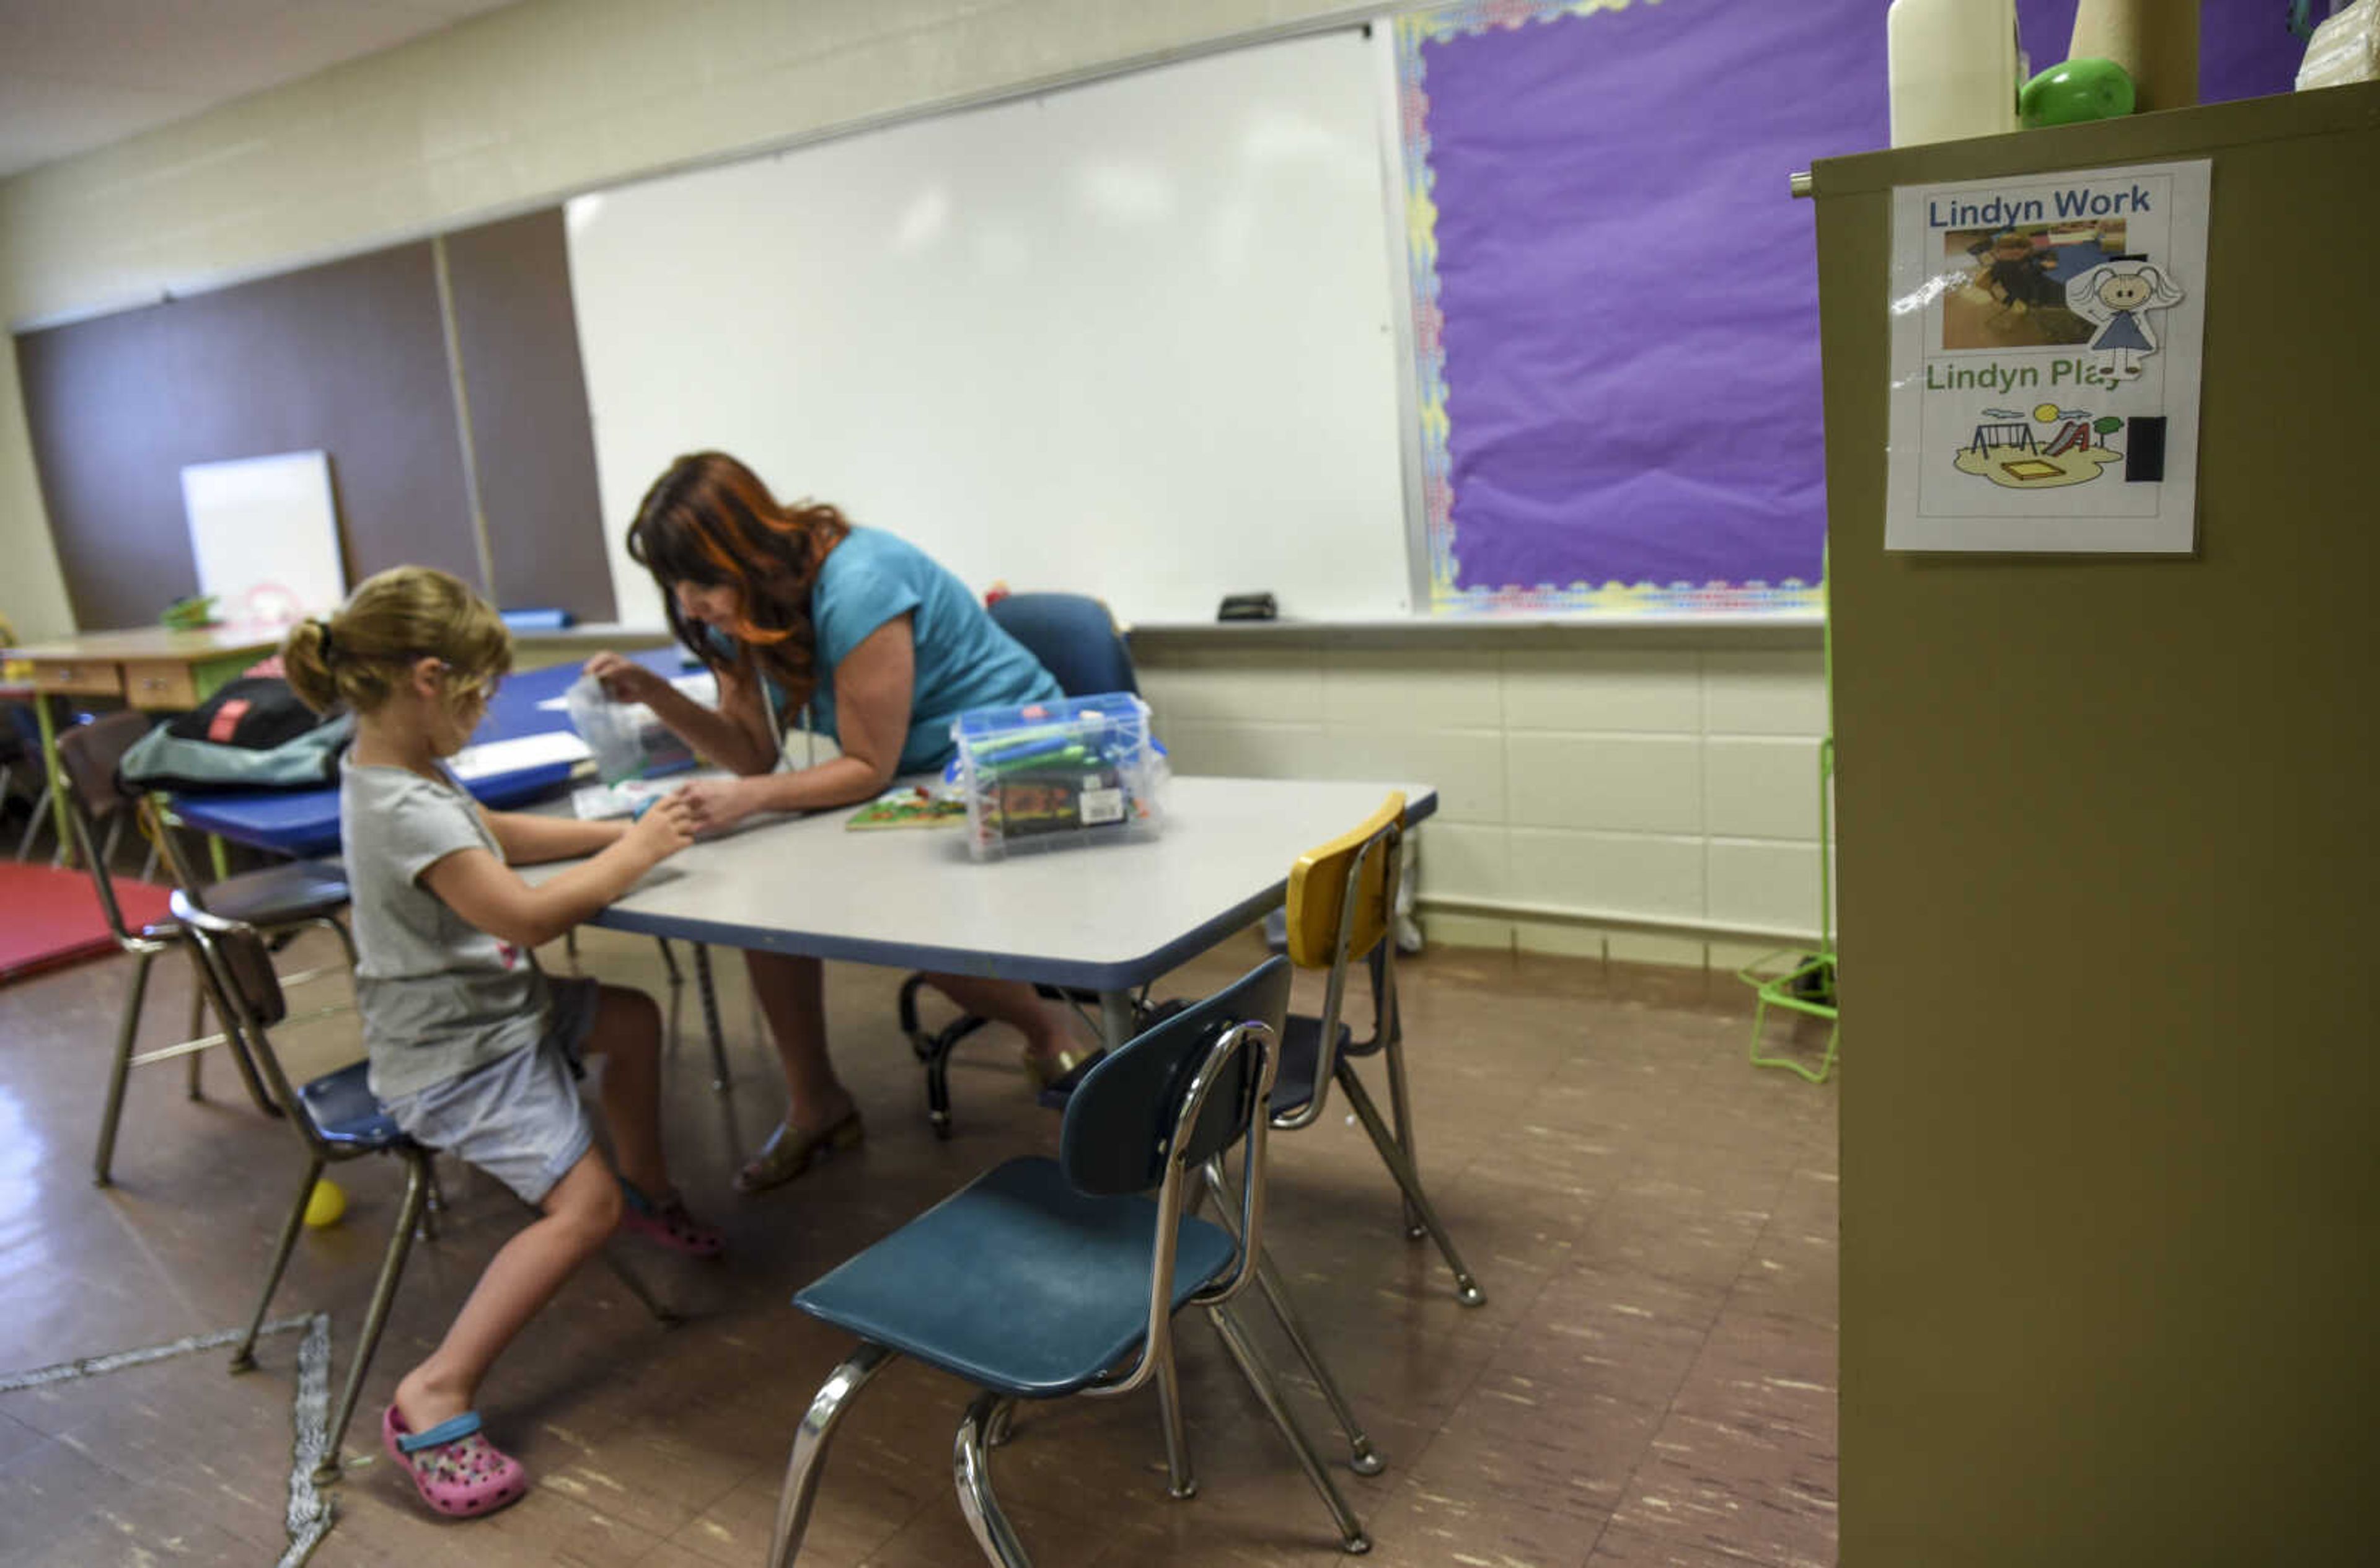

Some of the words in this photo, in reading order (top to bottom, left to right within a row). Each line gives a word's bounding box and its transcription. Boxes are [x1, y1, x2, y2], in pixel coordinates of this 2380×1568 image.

[1929, 196, 2043, 228] Lindyn
[2054, 185, 2151, 217] Work
[1926, 362, 2038, 394] Lindyn
